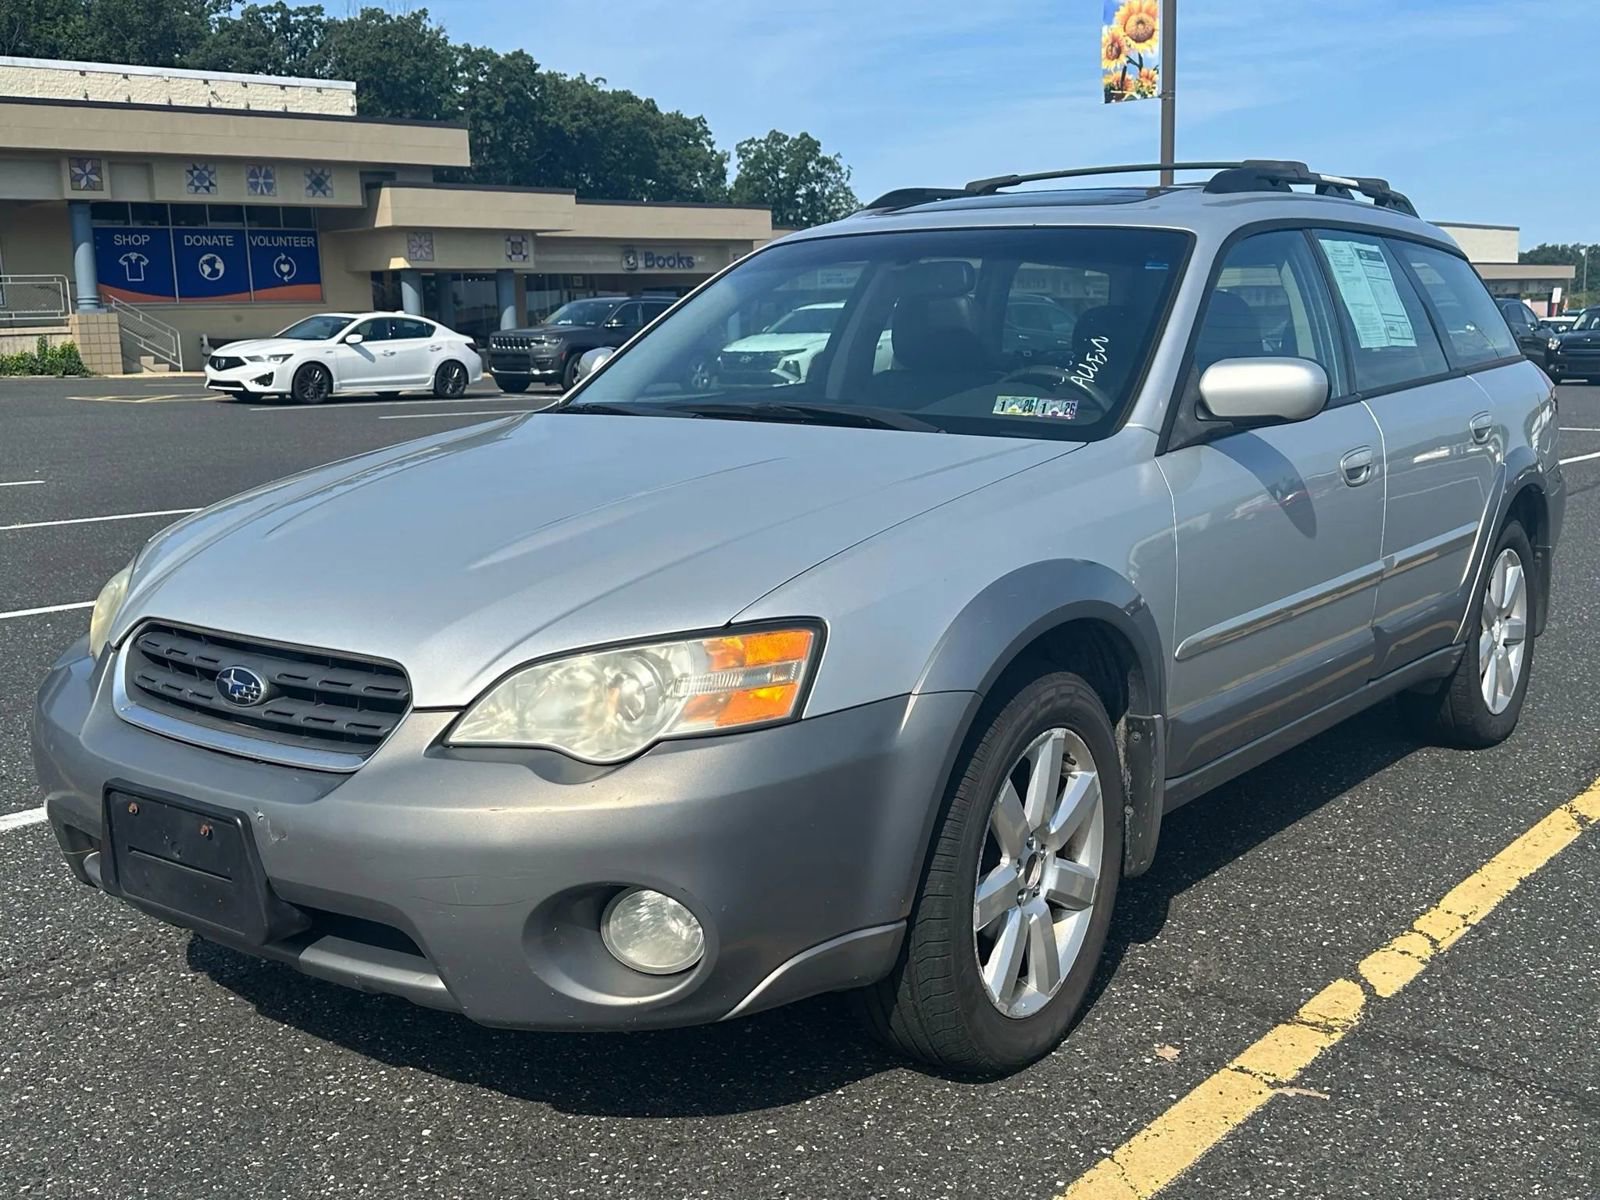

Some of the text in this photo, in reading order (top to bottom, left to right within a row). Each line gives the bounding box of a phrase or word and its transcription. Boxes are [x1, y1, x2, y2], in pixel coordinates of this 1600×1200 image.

[113, 234, 150, 246] SHOP
[184, 235, 234, 247] DONATE
[250, 236, 315, 247] VOLUNTEER
[644, 251, 695, 269] Books
[1022, 399, 1034, 413] 26
